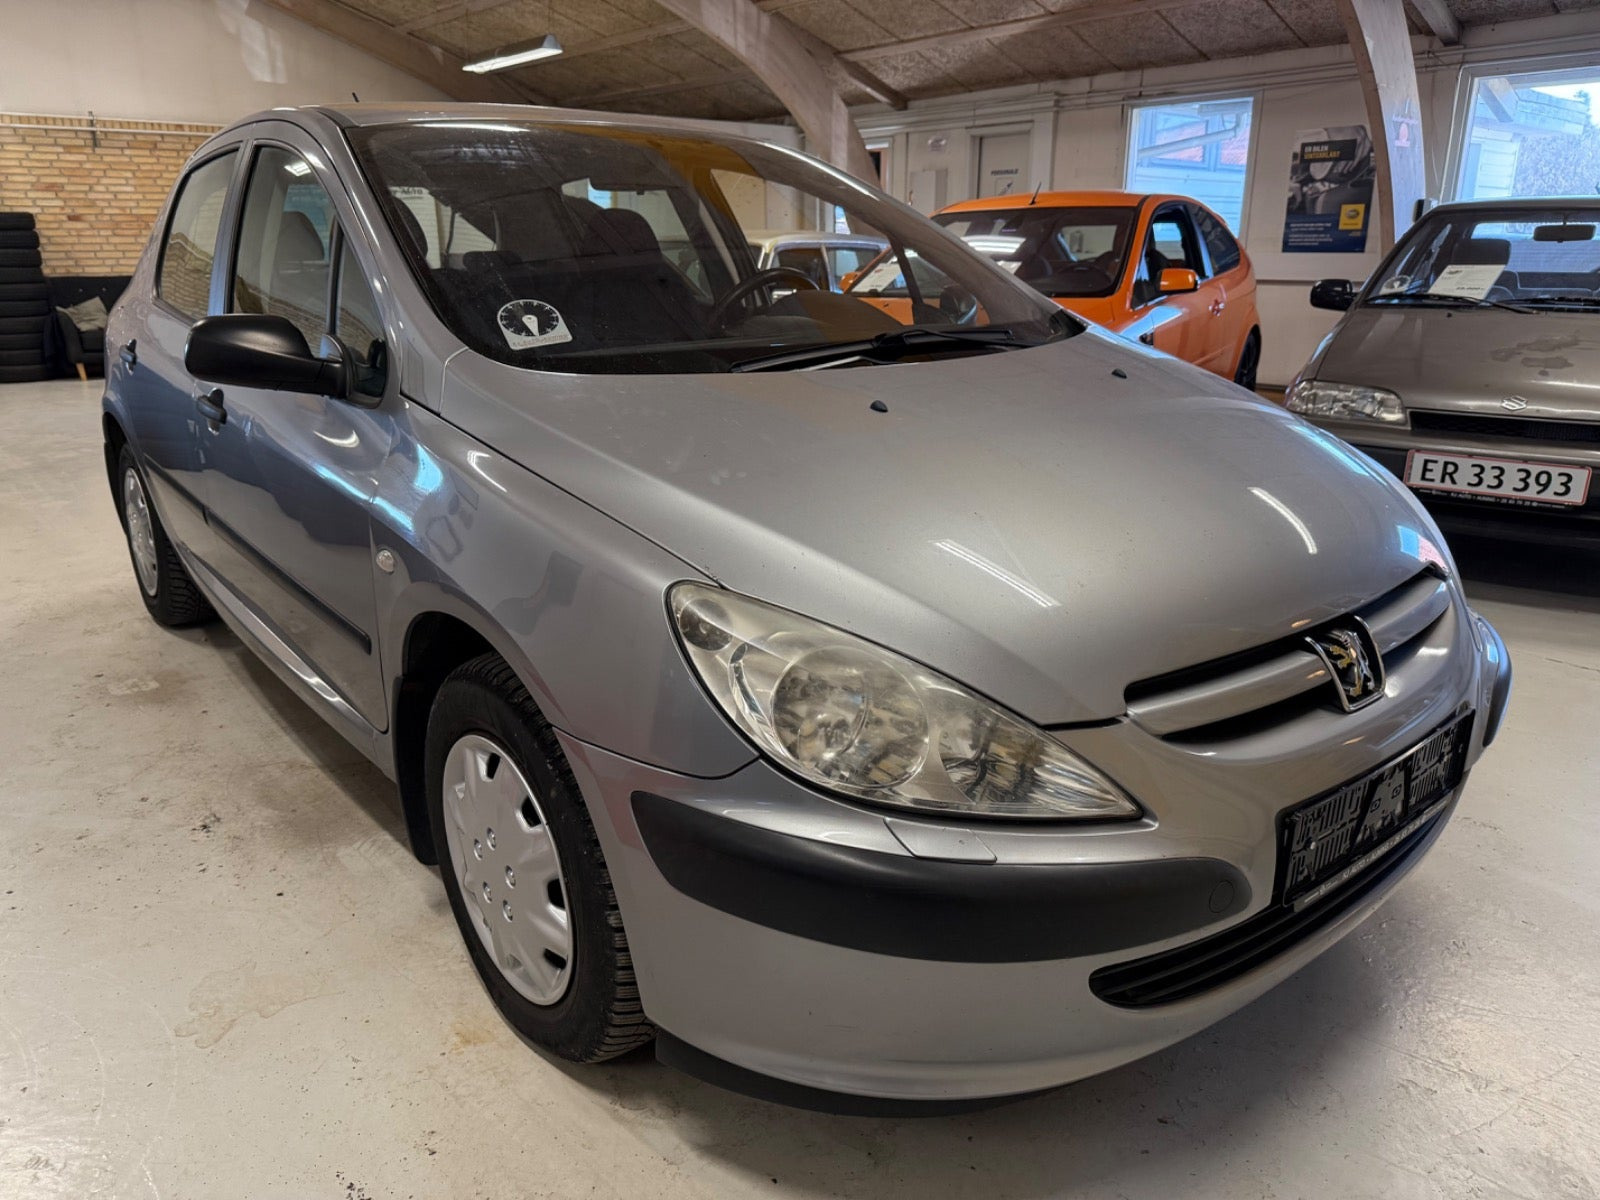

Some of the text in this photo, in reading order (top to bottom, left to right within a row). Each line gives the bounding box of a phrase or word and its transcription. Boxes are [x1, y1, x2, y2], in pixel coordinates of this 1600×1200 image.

[1420, 458, 1573, 497] ER 33 393
